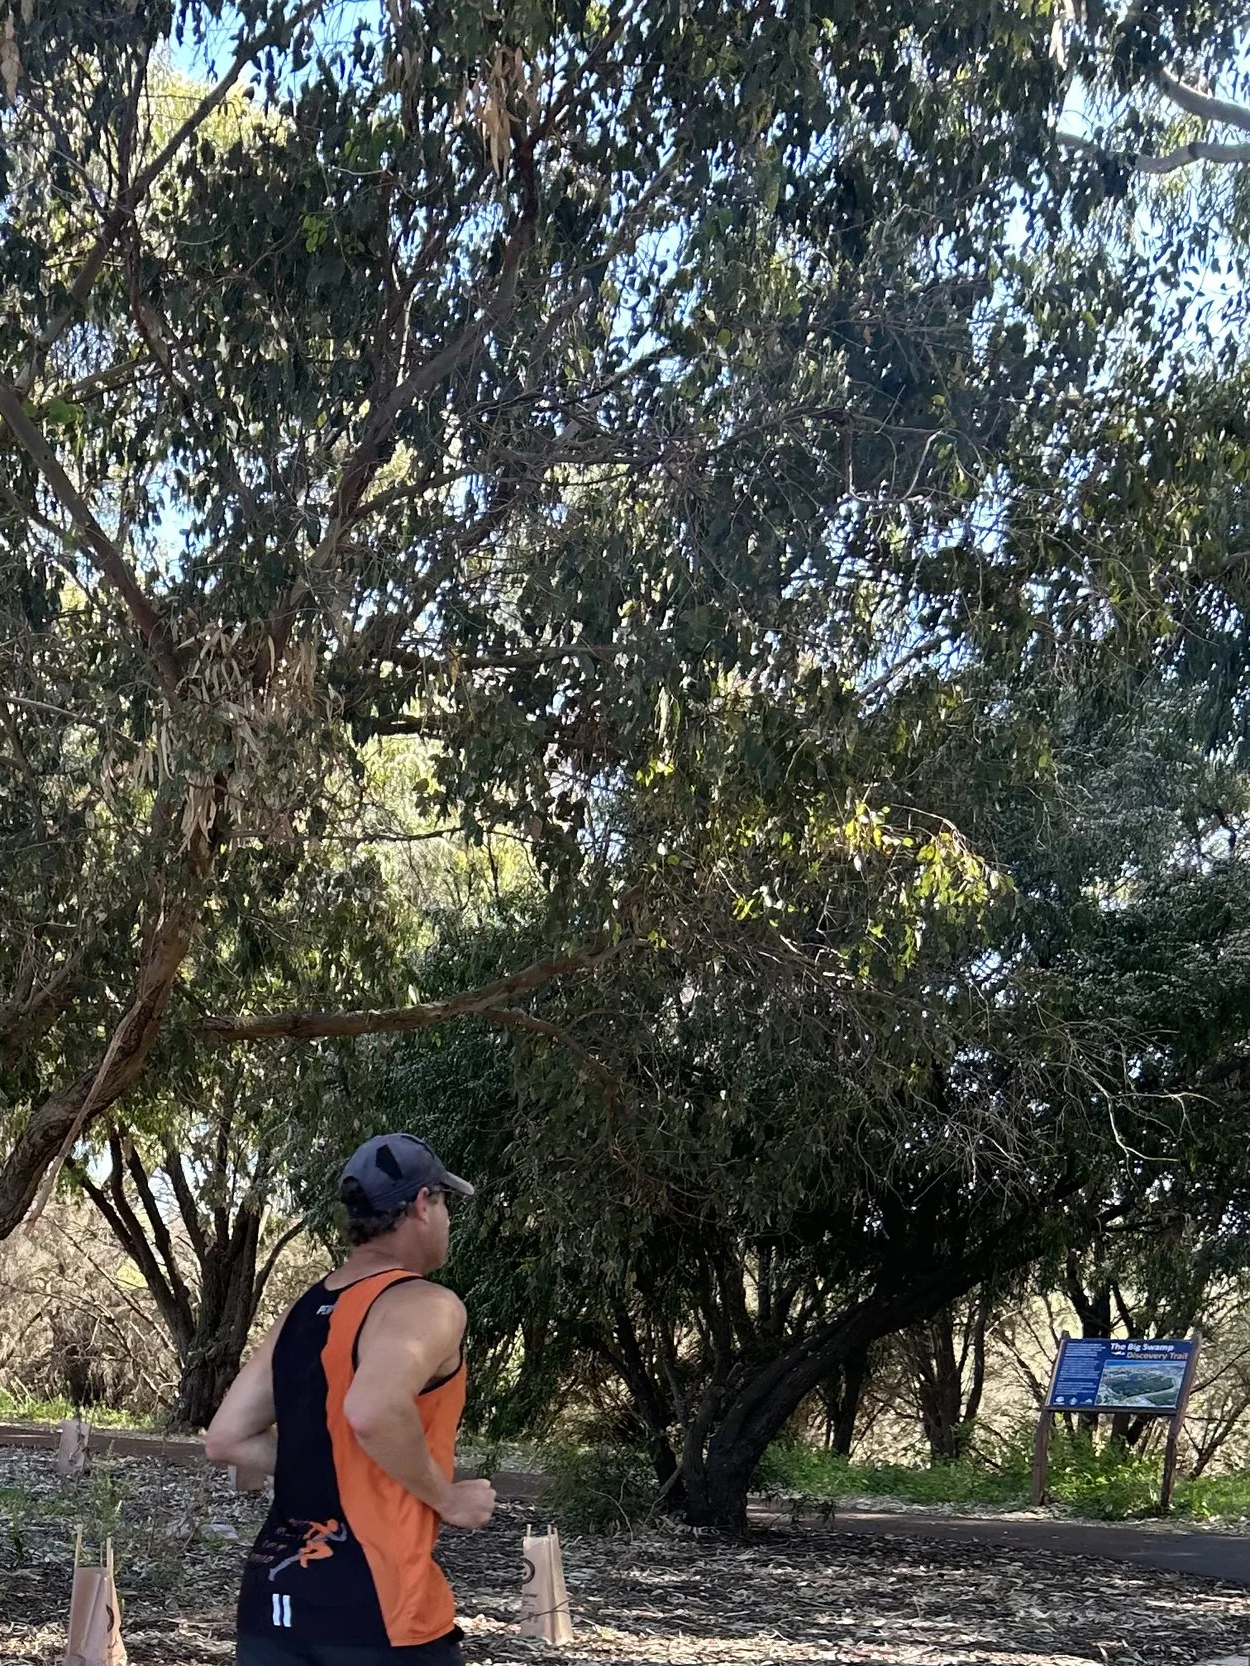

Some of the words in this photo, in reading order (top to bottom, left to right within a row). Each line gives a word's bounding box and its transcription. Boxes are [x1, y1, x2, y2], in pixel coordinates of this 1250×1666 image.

[1110, 1342, 1126, 1351] The
[1127, 1342, 1141, 1352] Big
[1142, 1343, 1174, 1352] Swamp
[1126, 1352, 1168, 1360] Discovery
[1170, 1352, 1188, 1360] Trail
